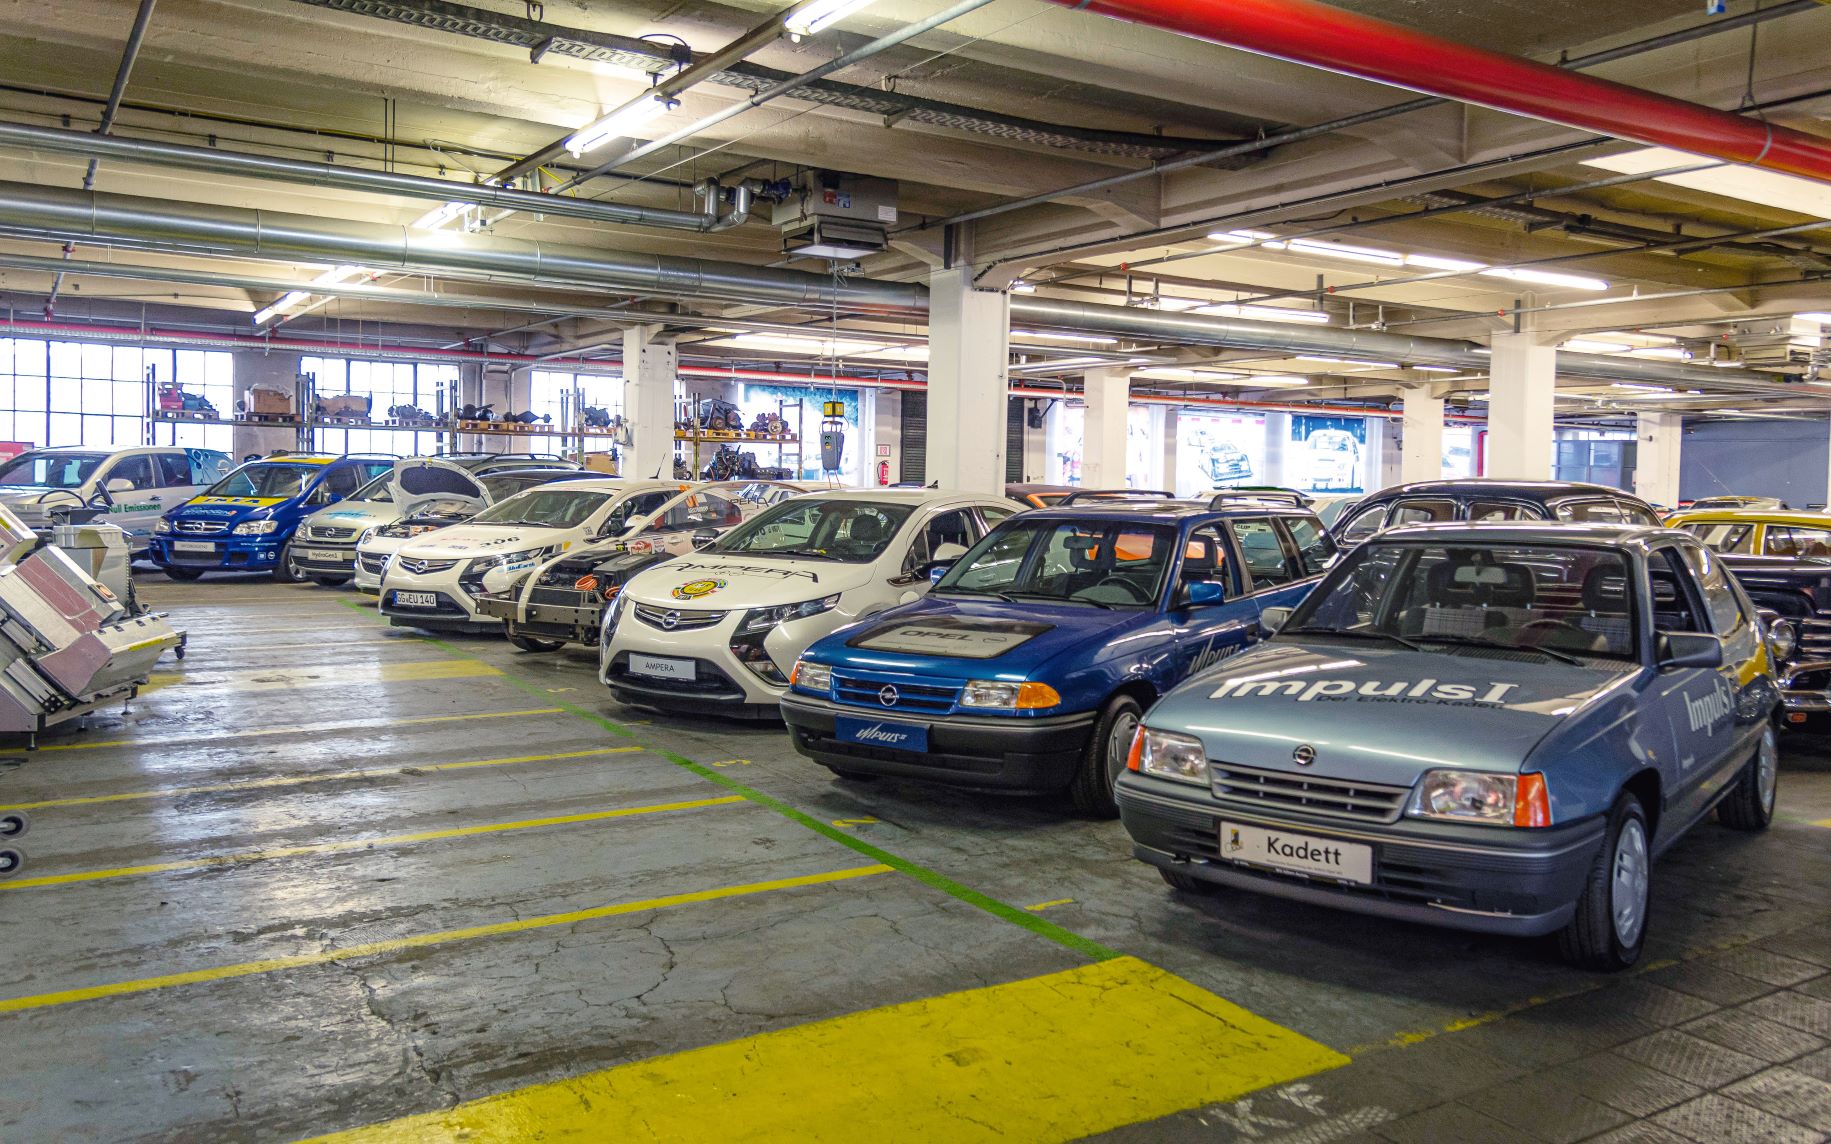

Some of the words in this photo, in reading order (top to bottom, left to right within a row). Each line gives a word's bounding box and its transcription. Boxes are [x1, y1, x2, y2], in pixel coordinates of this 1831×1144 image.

[124, 503, 162, 513] Emissionen
[651, 562, 819, 584] AMPERA
[408, 594, 419, 605] EU
[420, 594, 435, 606] 140
[900, 629, 975, 642] OPEL
[645, 662, 675, 672] AMPERA
[1267, 836, 1342, 866] Kadett
